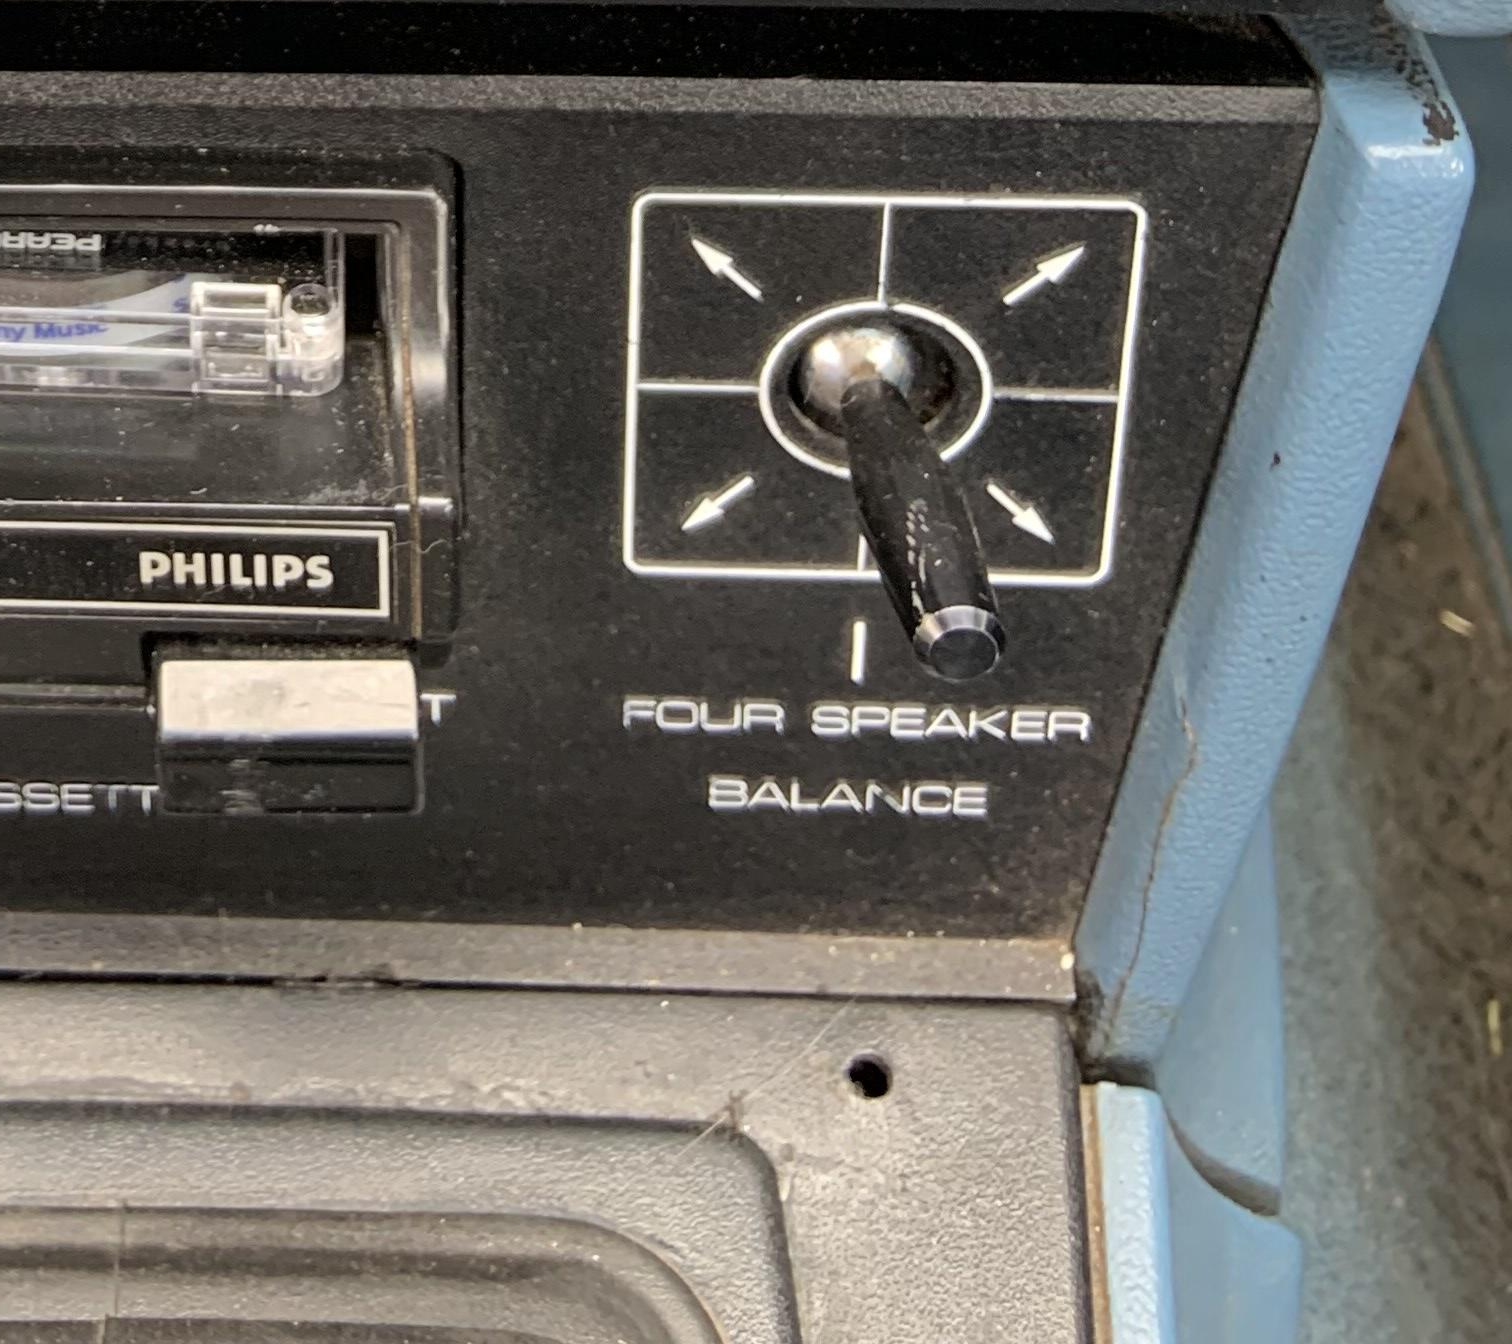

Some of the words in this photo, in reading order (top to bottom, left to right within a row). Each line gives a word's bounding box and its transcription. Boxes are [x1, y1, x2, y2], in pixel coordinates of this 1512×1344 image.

[138, 551, 334, 589] PHILIPS
[623, 698, 785, 735] FOUR
[810, 703, 1092, 742] SPEAKER
[707, 777, 990, 816] BALANCE
